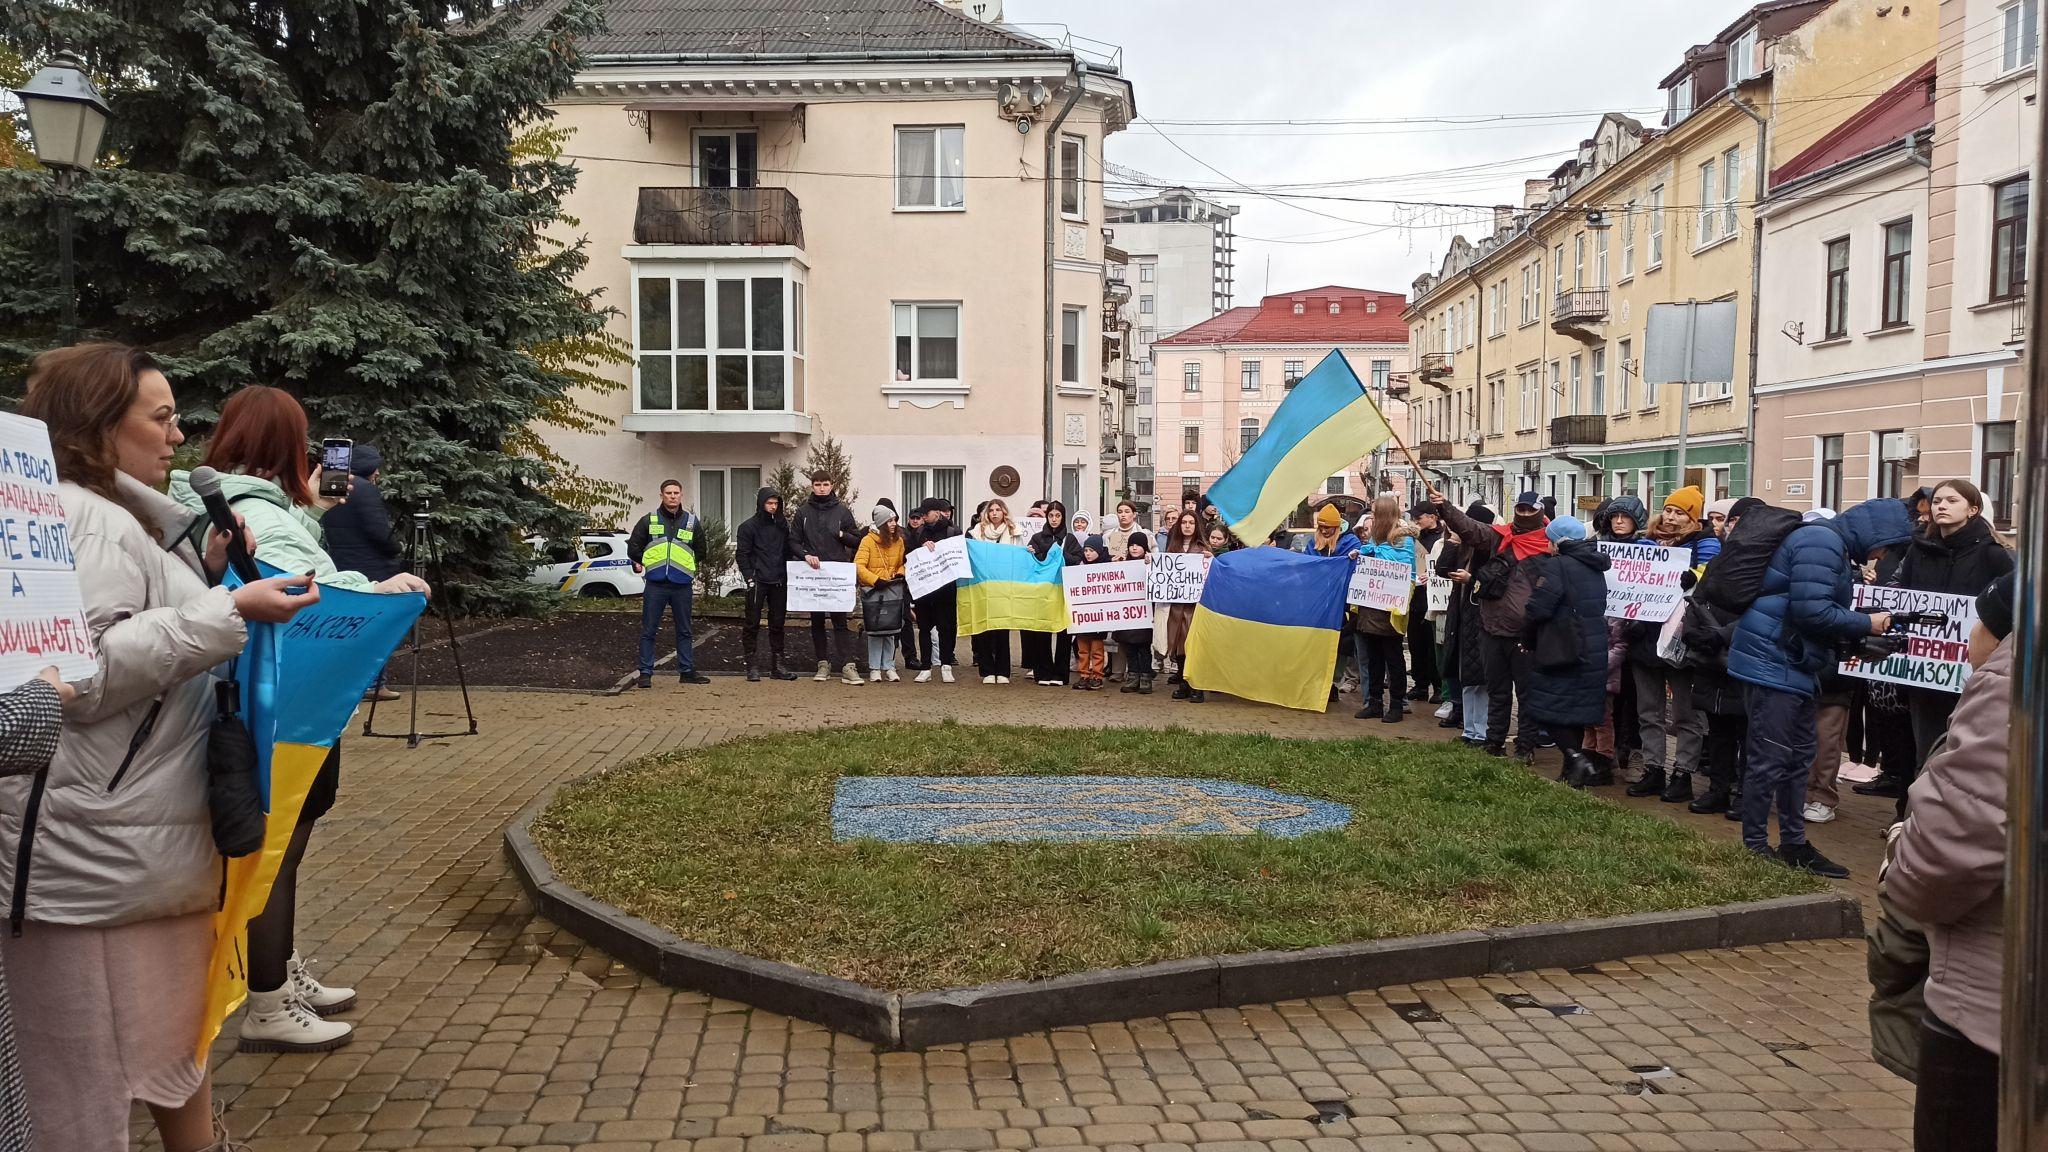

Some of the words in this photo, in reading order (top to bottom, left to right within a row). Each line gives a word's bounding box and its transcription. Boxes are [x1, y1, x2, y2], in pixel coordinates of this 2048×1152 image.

[0, 448, 14, 475] А
[14, 451, 52, 485] ТВОЮ
[1600, 544, 1669, 562] ВИМАГАЄМО
[1370, 559, 1409, 574] ПЕРЕМОГУ
[12, 571, 26, 597] А
[1086, 570, 1126, 583] БРУКІВКА
[1368, 578, 1385, 590] ВСІ
[1070, 586, 1080, 597] НЕ
[1081, 584, 1112, 596] ВРЯТУЄ
[1113, 581, 1145, 593] ЖИТТЯ!
[1348, 587, 1366, 601] ПОРА
[1367, 591, 1406, 608] МІНЯТИСЯ
[1072, 608, 1104, 626] Гроші
[1106, 610, 1120, 621] на
[1122, 604, 1147, 620] ЗСУ!
[1623, 601, 1642, 619] 18
[0, 608, 94, 660] ХИЩАЮТЬ!
